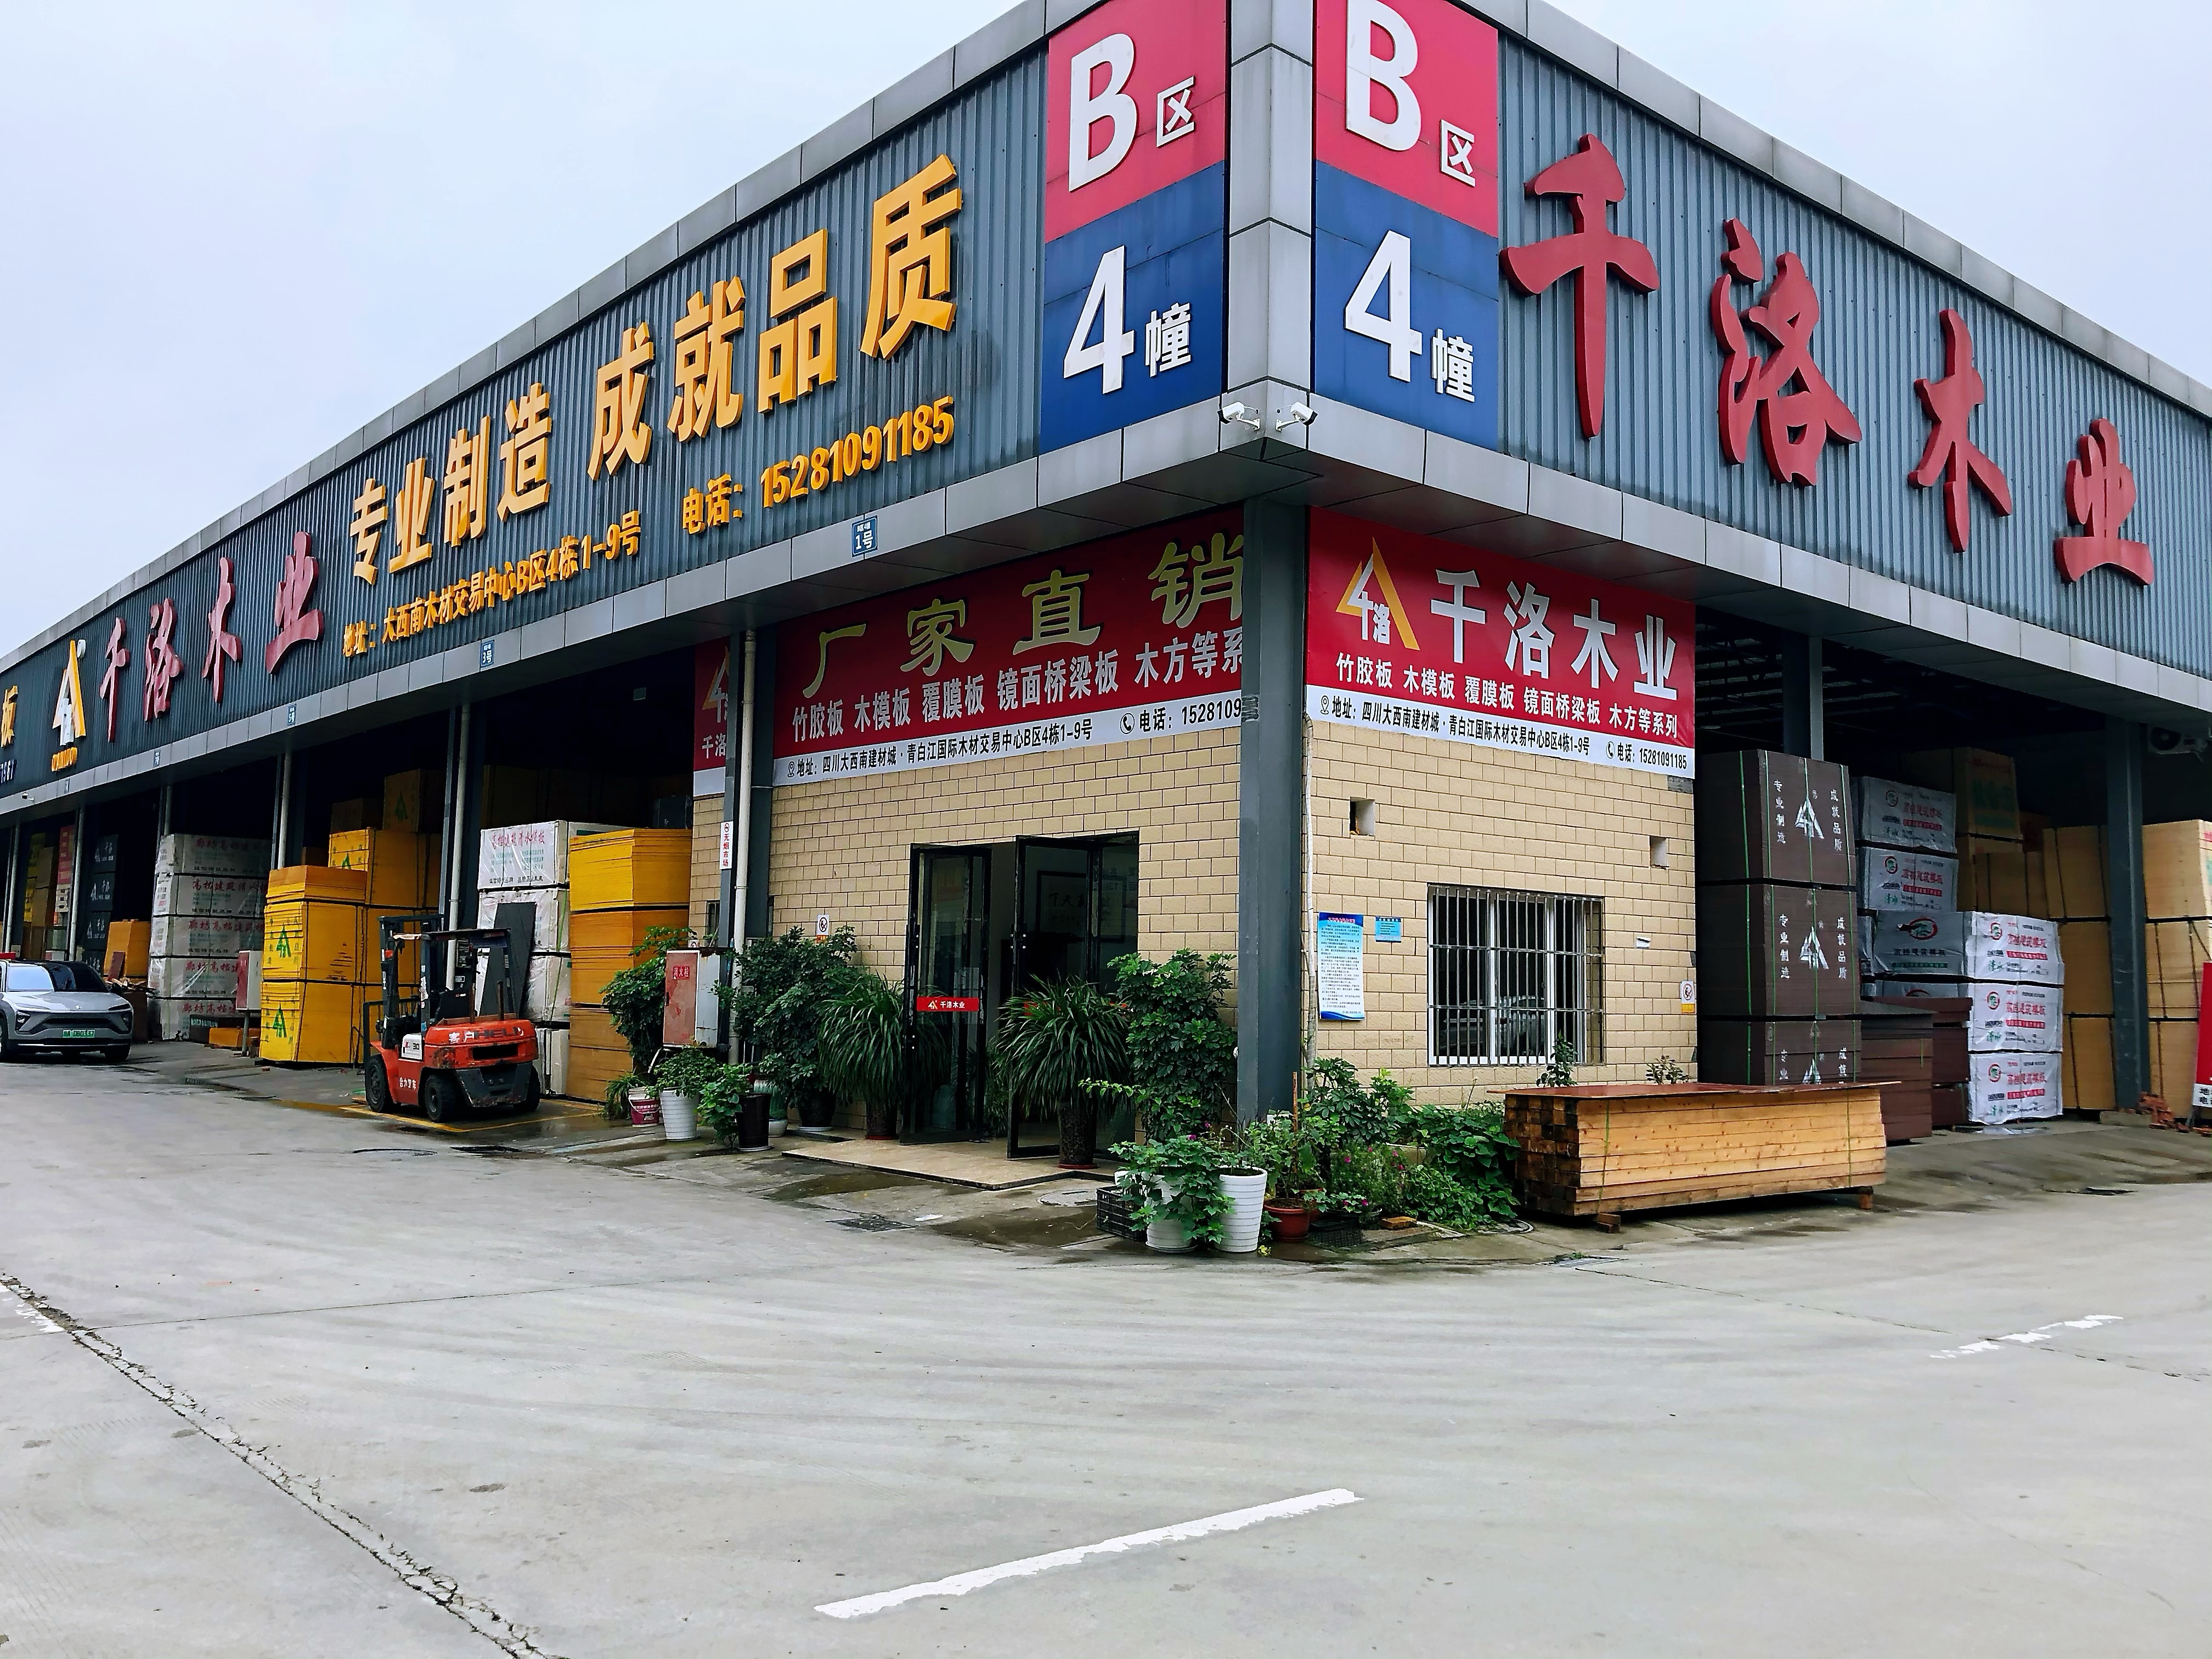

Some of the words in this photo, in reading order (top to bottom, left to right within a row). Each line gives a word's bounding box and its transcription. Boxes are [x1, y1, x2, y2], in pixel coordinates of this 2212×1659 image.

[1068, 33, 1195, 192] B区
[1346, 0, 1476, 187] B区
[350, 382, 552, 585] 专业制造
[588, 154, 962, 481] 成就品质
[1064, 245, 1191, 394] 4幢
[1345, 230, 1475, 402] 4幢
[1499, 133, 2154, 585] 千洛木业
[855, 529, 874, 551] 1号
[99, 531, 325, 743] 千洛木业
[482, 650, 493, 663] 3号
[803, 533, 1244, 698] 厂家直销
[1431, 569, 1678, 701] 千洛木业
[792, 698, 844, 743] 竹胶板
[854, 687, 911, 733] 木模板
[922, 674, 985, 723] 覆膜板
[997, 649, 1119, 712] 镜面桥梁板
[1335, 652, 1393, 690] 竹胶板
[1403, 664, 1455, 701] 木模板
[1464, 676, 1515, 711] 覆膜板
[1524, 686, 1601, 725] 镜面桥梁板
[1609, 706, 1678, 739] 木方等系列
[1773, 779, 1787, 844] 专业制造
[1830, 788, 1843, 851] 成就品质
[1779, 913, 1791, 979] 专业制造
[1837, 916, 1847, 980] 成就品质
[1838, 1046, 1848, 1084] 成就
